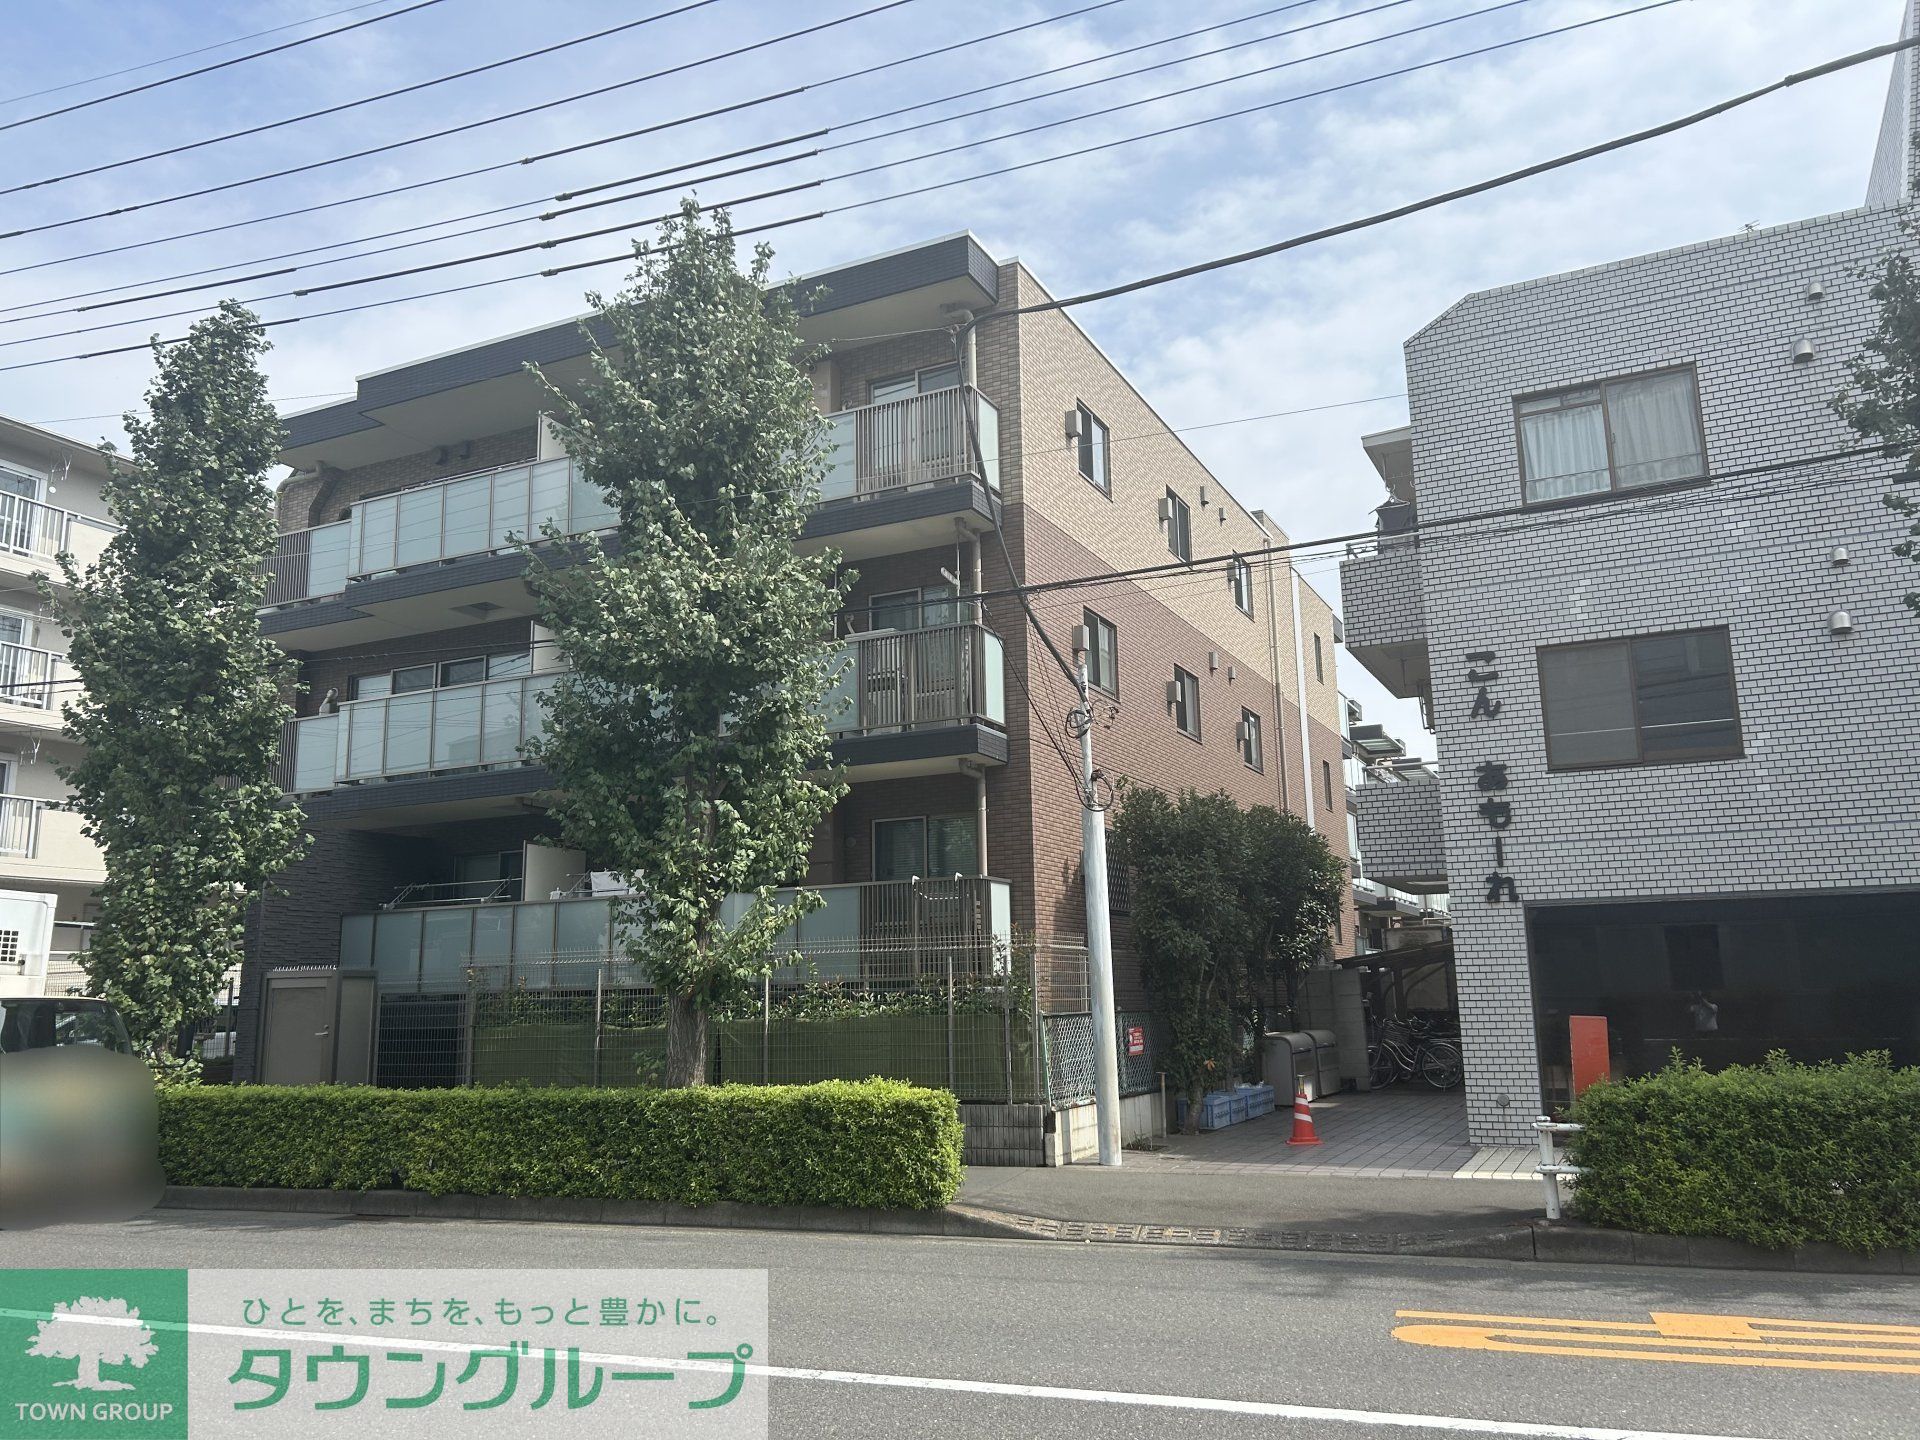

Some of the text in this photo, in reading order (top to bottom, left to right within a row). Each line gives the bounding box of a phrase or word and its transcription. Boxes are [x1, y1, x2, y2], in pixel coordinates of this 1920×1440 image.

[1465, 650, 1520, 903] こん あもーれ
